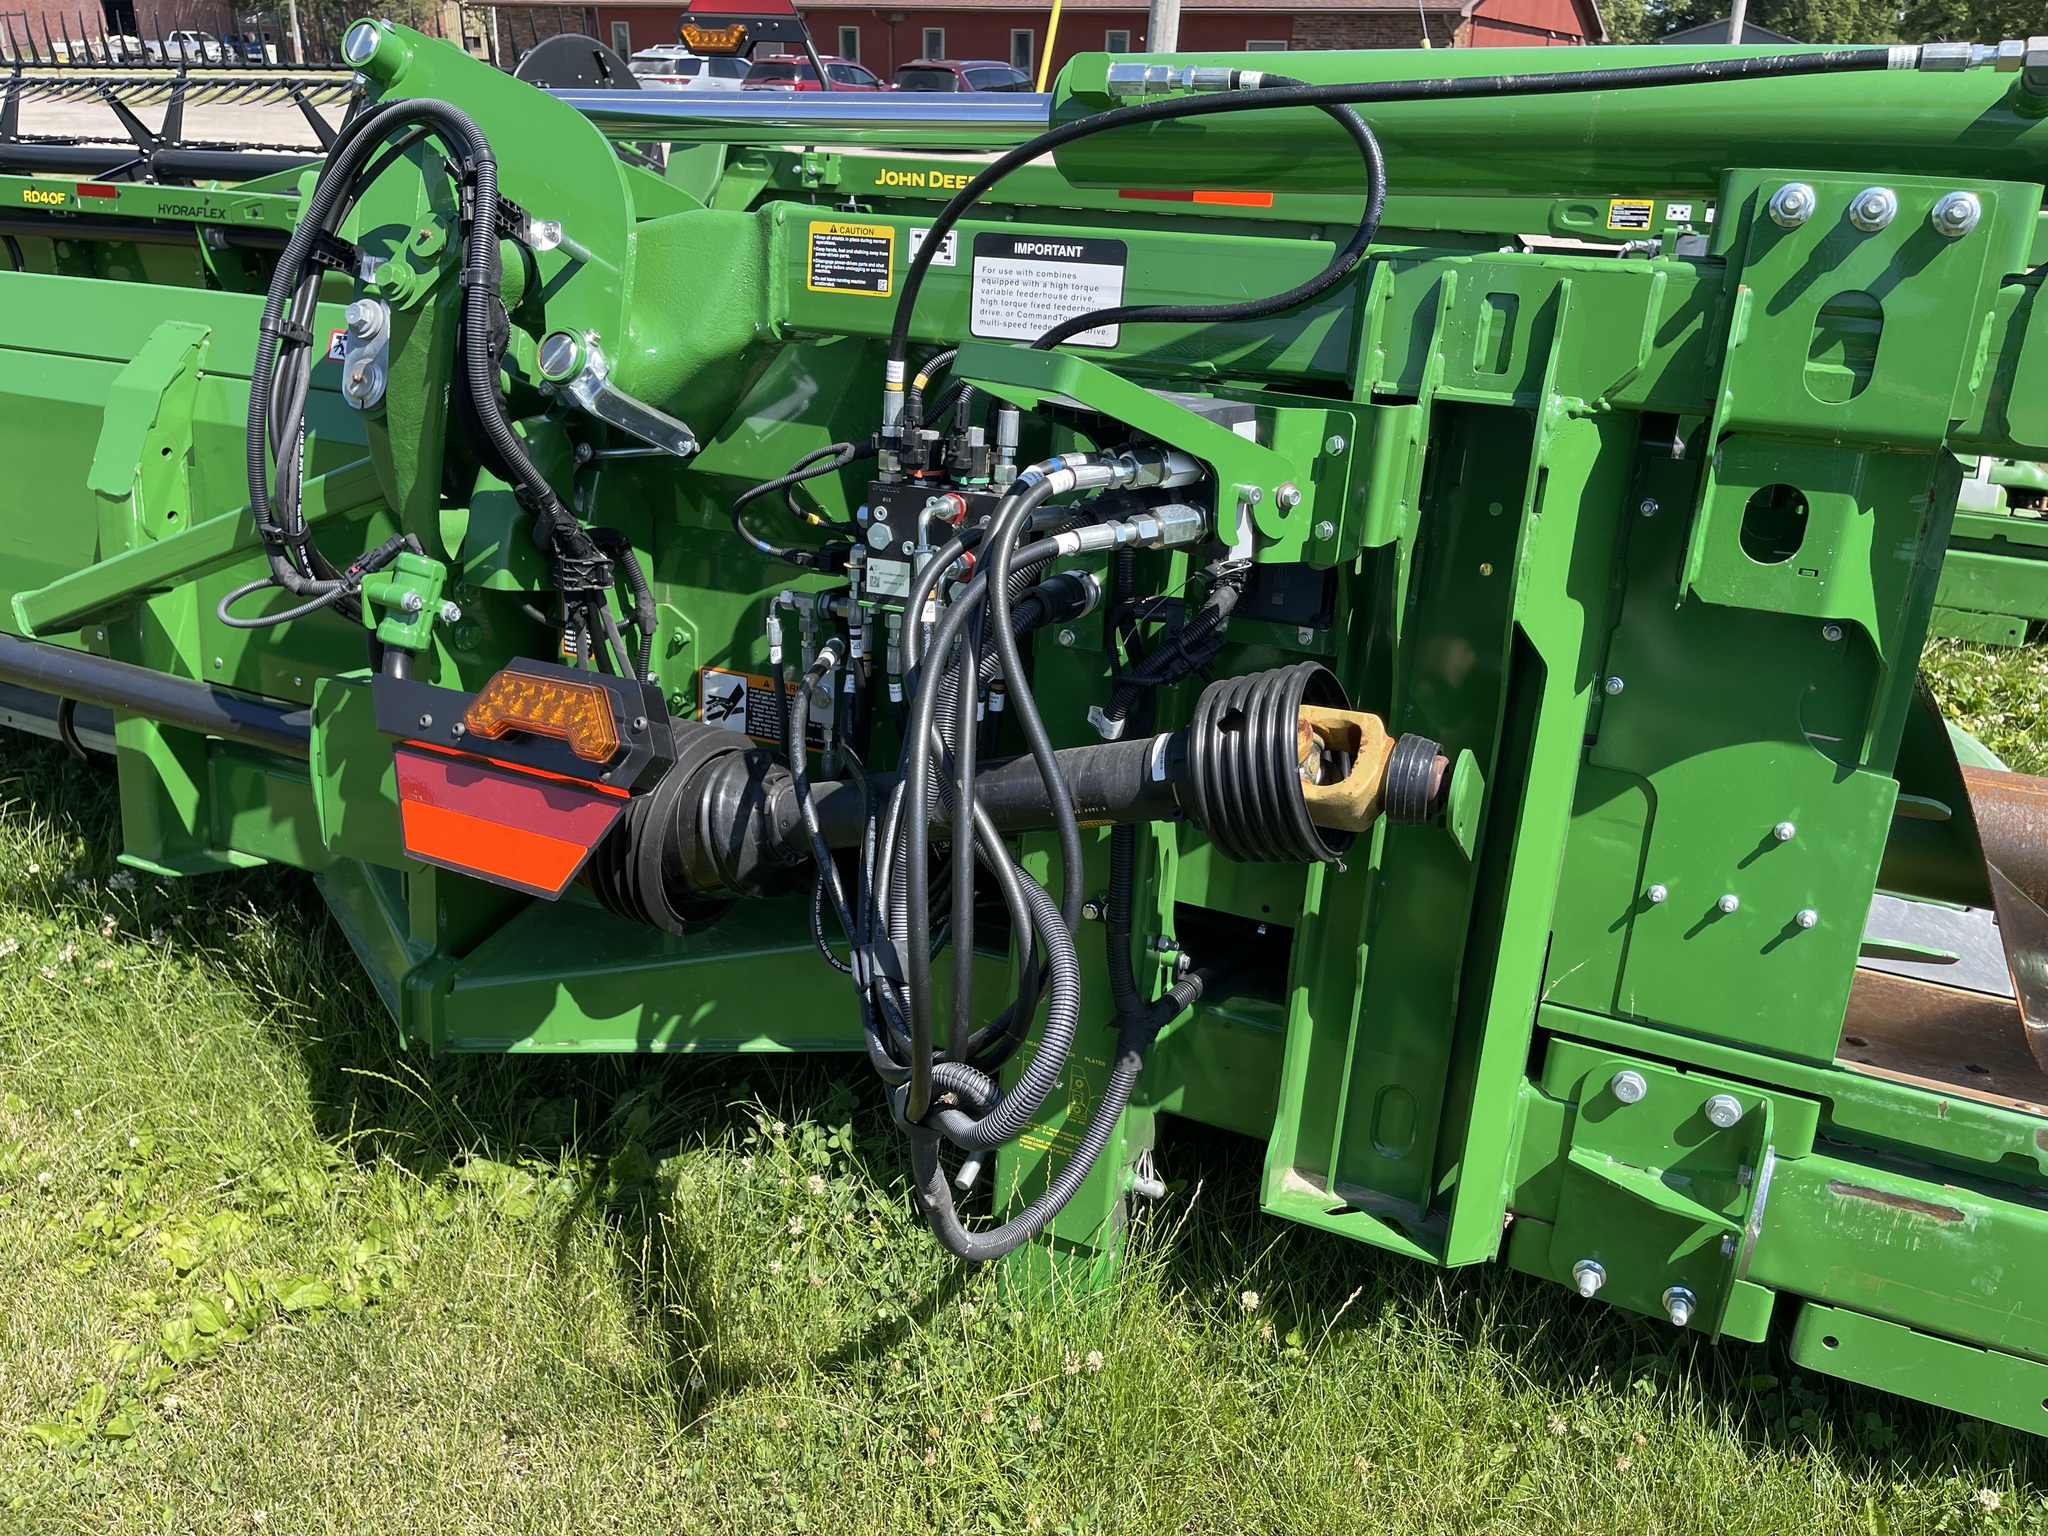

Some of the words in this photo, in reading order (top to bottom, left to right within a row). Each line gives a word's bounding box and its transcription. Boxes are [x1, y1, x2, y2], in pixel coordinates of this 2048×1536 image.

[875, 168, 925, 187] JOHN
[929, 170, 993, 191] DEE
[22, 189, 66, 205] RD40F
[158, 203, 226, 220] HYDRAFLEX
[840, 227, 874, 235] CAUTION
[1014, 242, 1083, 257] IMPORTANT
[982, 266, 995, 274] For
[1036, 270, 1077, 280] combines
[981, 278, 1019, 287] equipped
[1050, 281, 1068, 292] high
[1072, 283, 1099, 293] torque
[981, 288, 1014, 297] variable
[1016, 290, 1068, 301] feederhouse
[1071, 294, 1095, 303] drive,
[981, 298, 998, 307] high
[1001, 300, 1028, 310] torque
[1030, 301, 1051, 310] fixed
[979, 319, 1027, 329] multi-speed
[1084, 1057, 1106, 1067] PLATES
